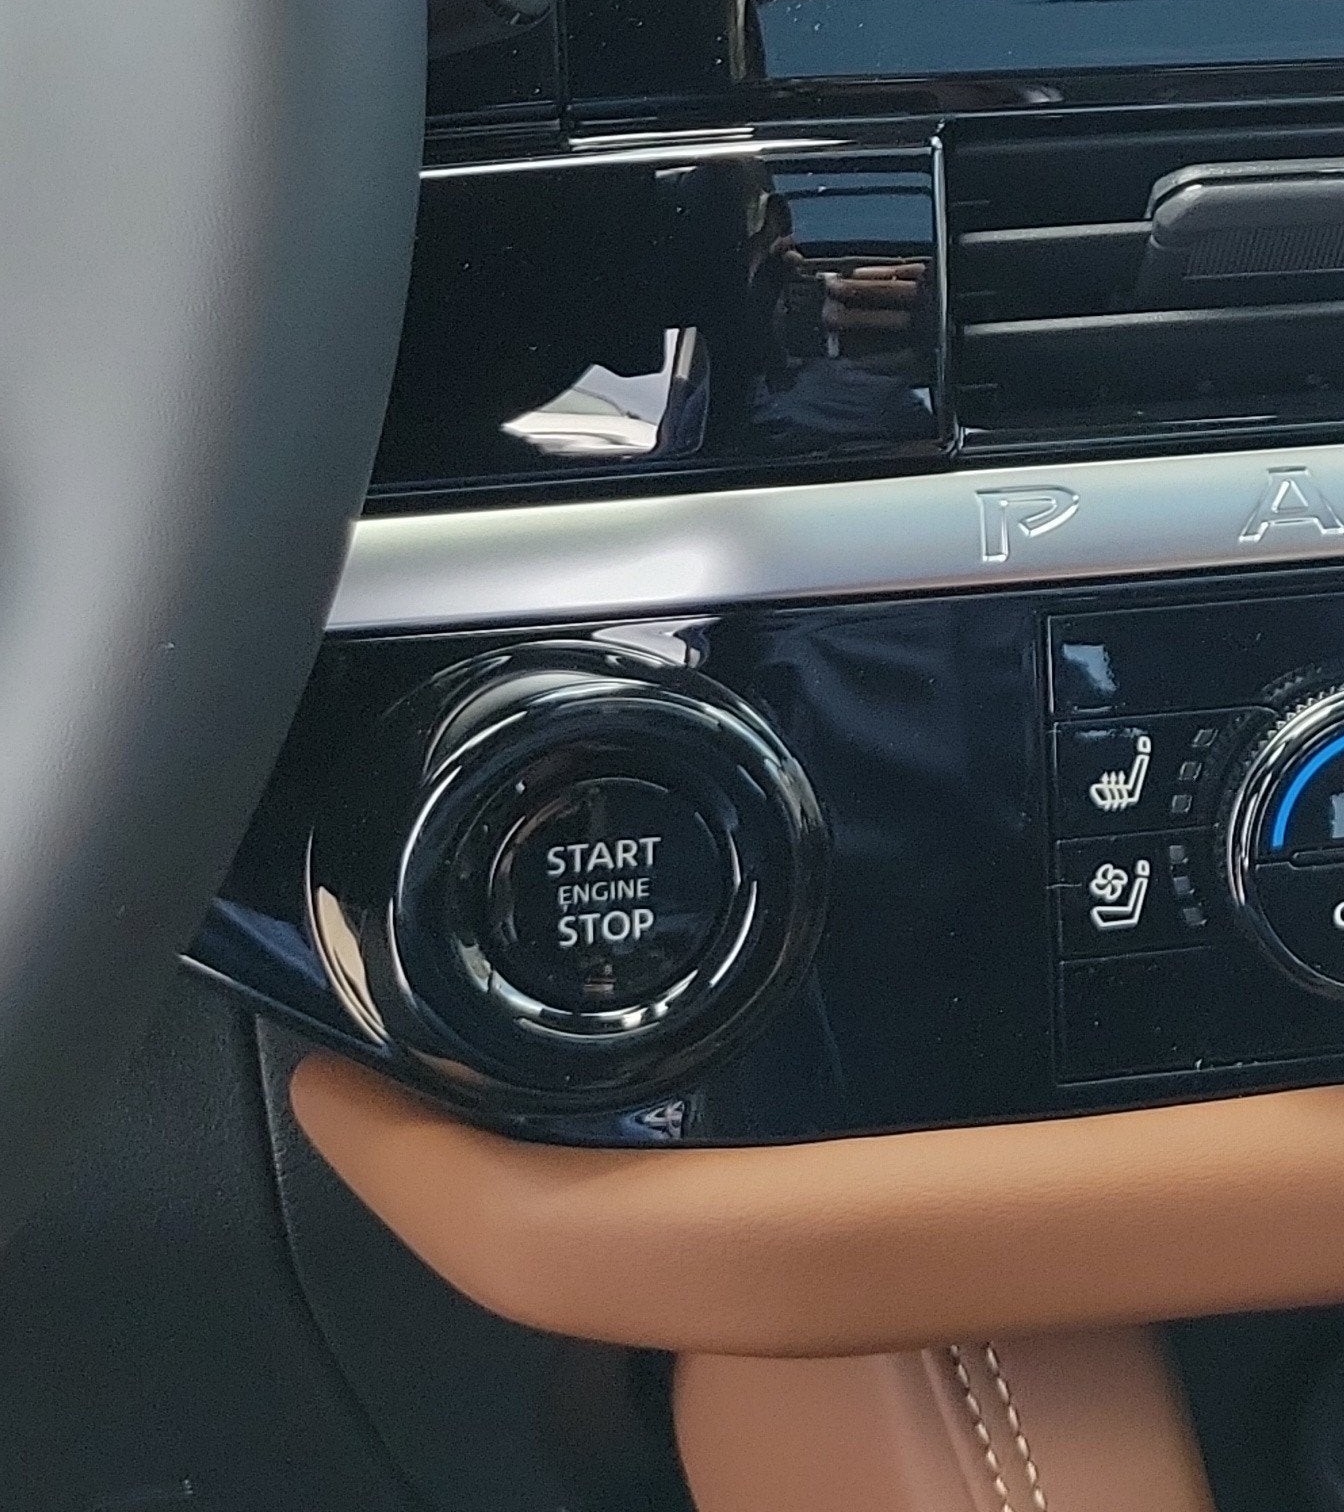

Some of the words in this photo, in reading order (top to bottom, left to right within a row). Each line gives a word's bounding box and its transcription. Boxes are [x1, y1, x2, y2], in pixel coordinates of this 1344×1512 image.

[546, 837, 661, 876] START
[558, 878, 650, 906] ENGINE
[557, 909, 655, 948] STOP
